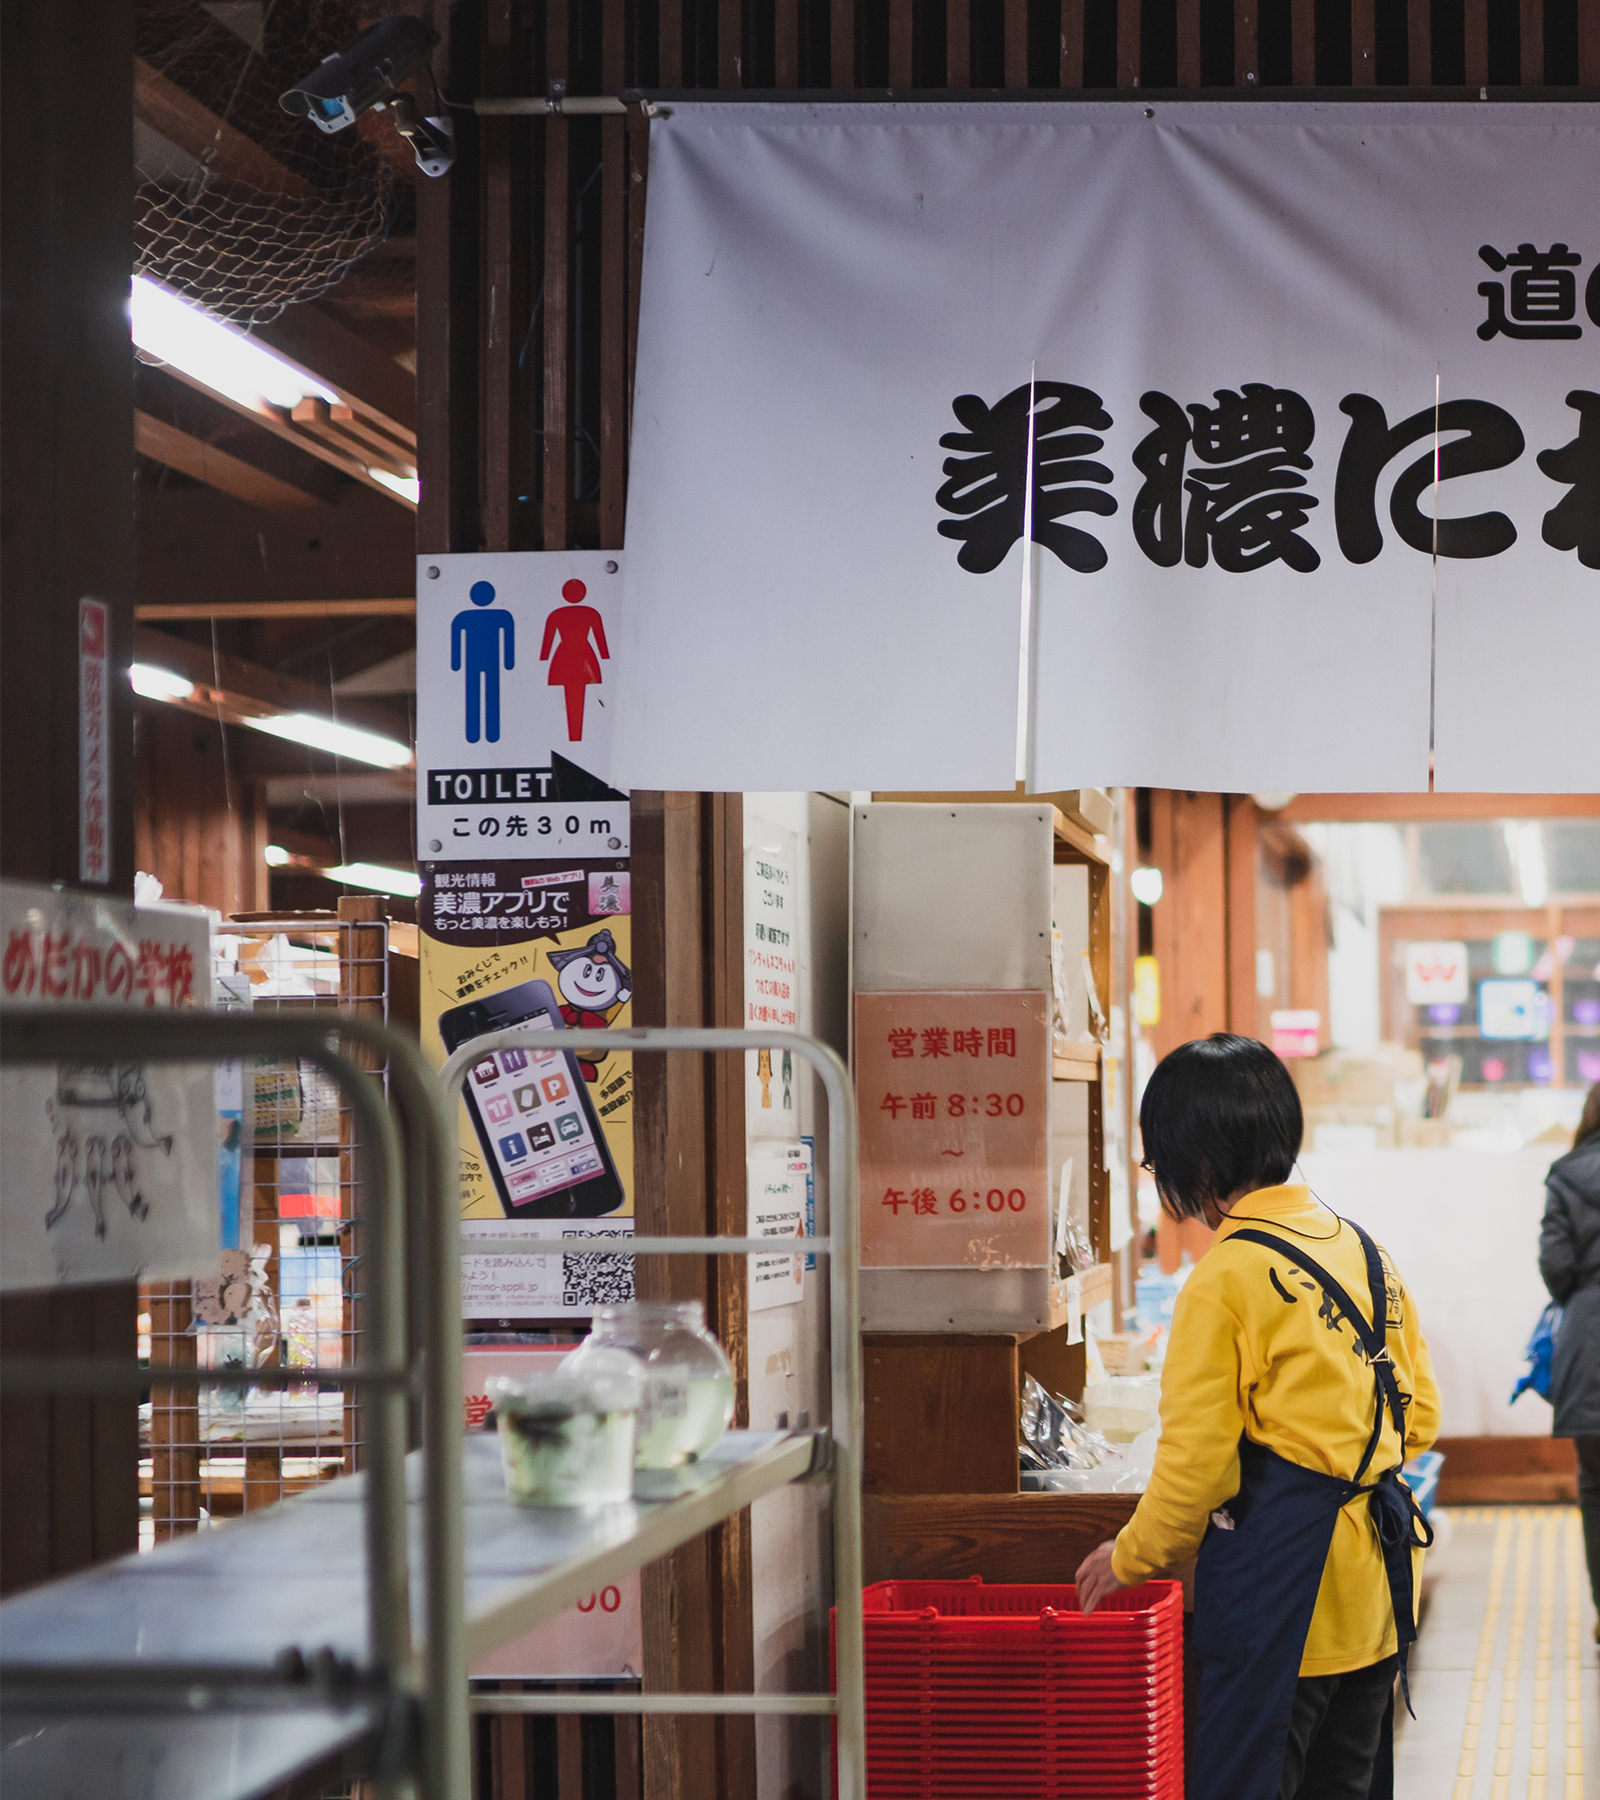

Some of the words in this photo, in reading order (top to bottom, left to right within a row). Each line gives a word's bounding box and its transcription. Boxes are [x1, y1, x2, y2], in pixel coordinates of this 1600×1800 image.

[434, 773, 553, 800] TOILET
[434, 873, 496, 888] 観光情報
[433, 889, 570, 915] 美濃アプリで
[434, 917, 568, 930] もっと美濃を楽しもう!
[2, 930, 194, 1007] めだかの学校
[887, 1027, 1017, 1060] 営業時間
[880, 1093, 938, 1120] 午前
[947, 1092, 1025, 1118] 8:30
[881, 1188, 939, 1216] 午後
[948, 1187, 1027, 1213] 6:00
